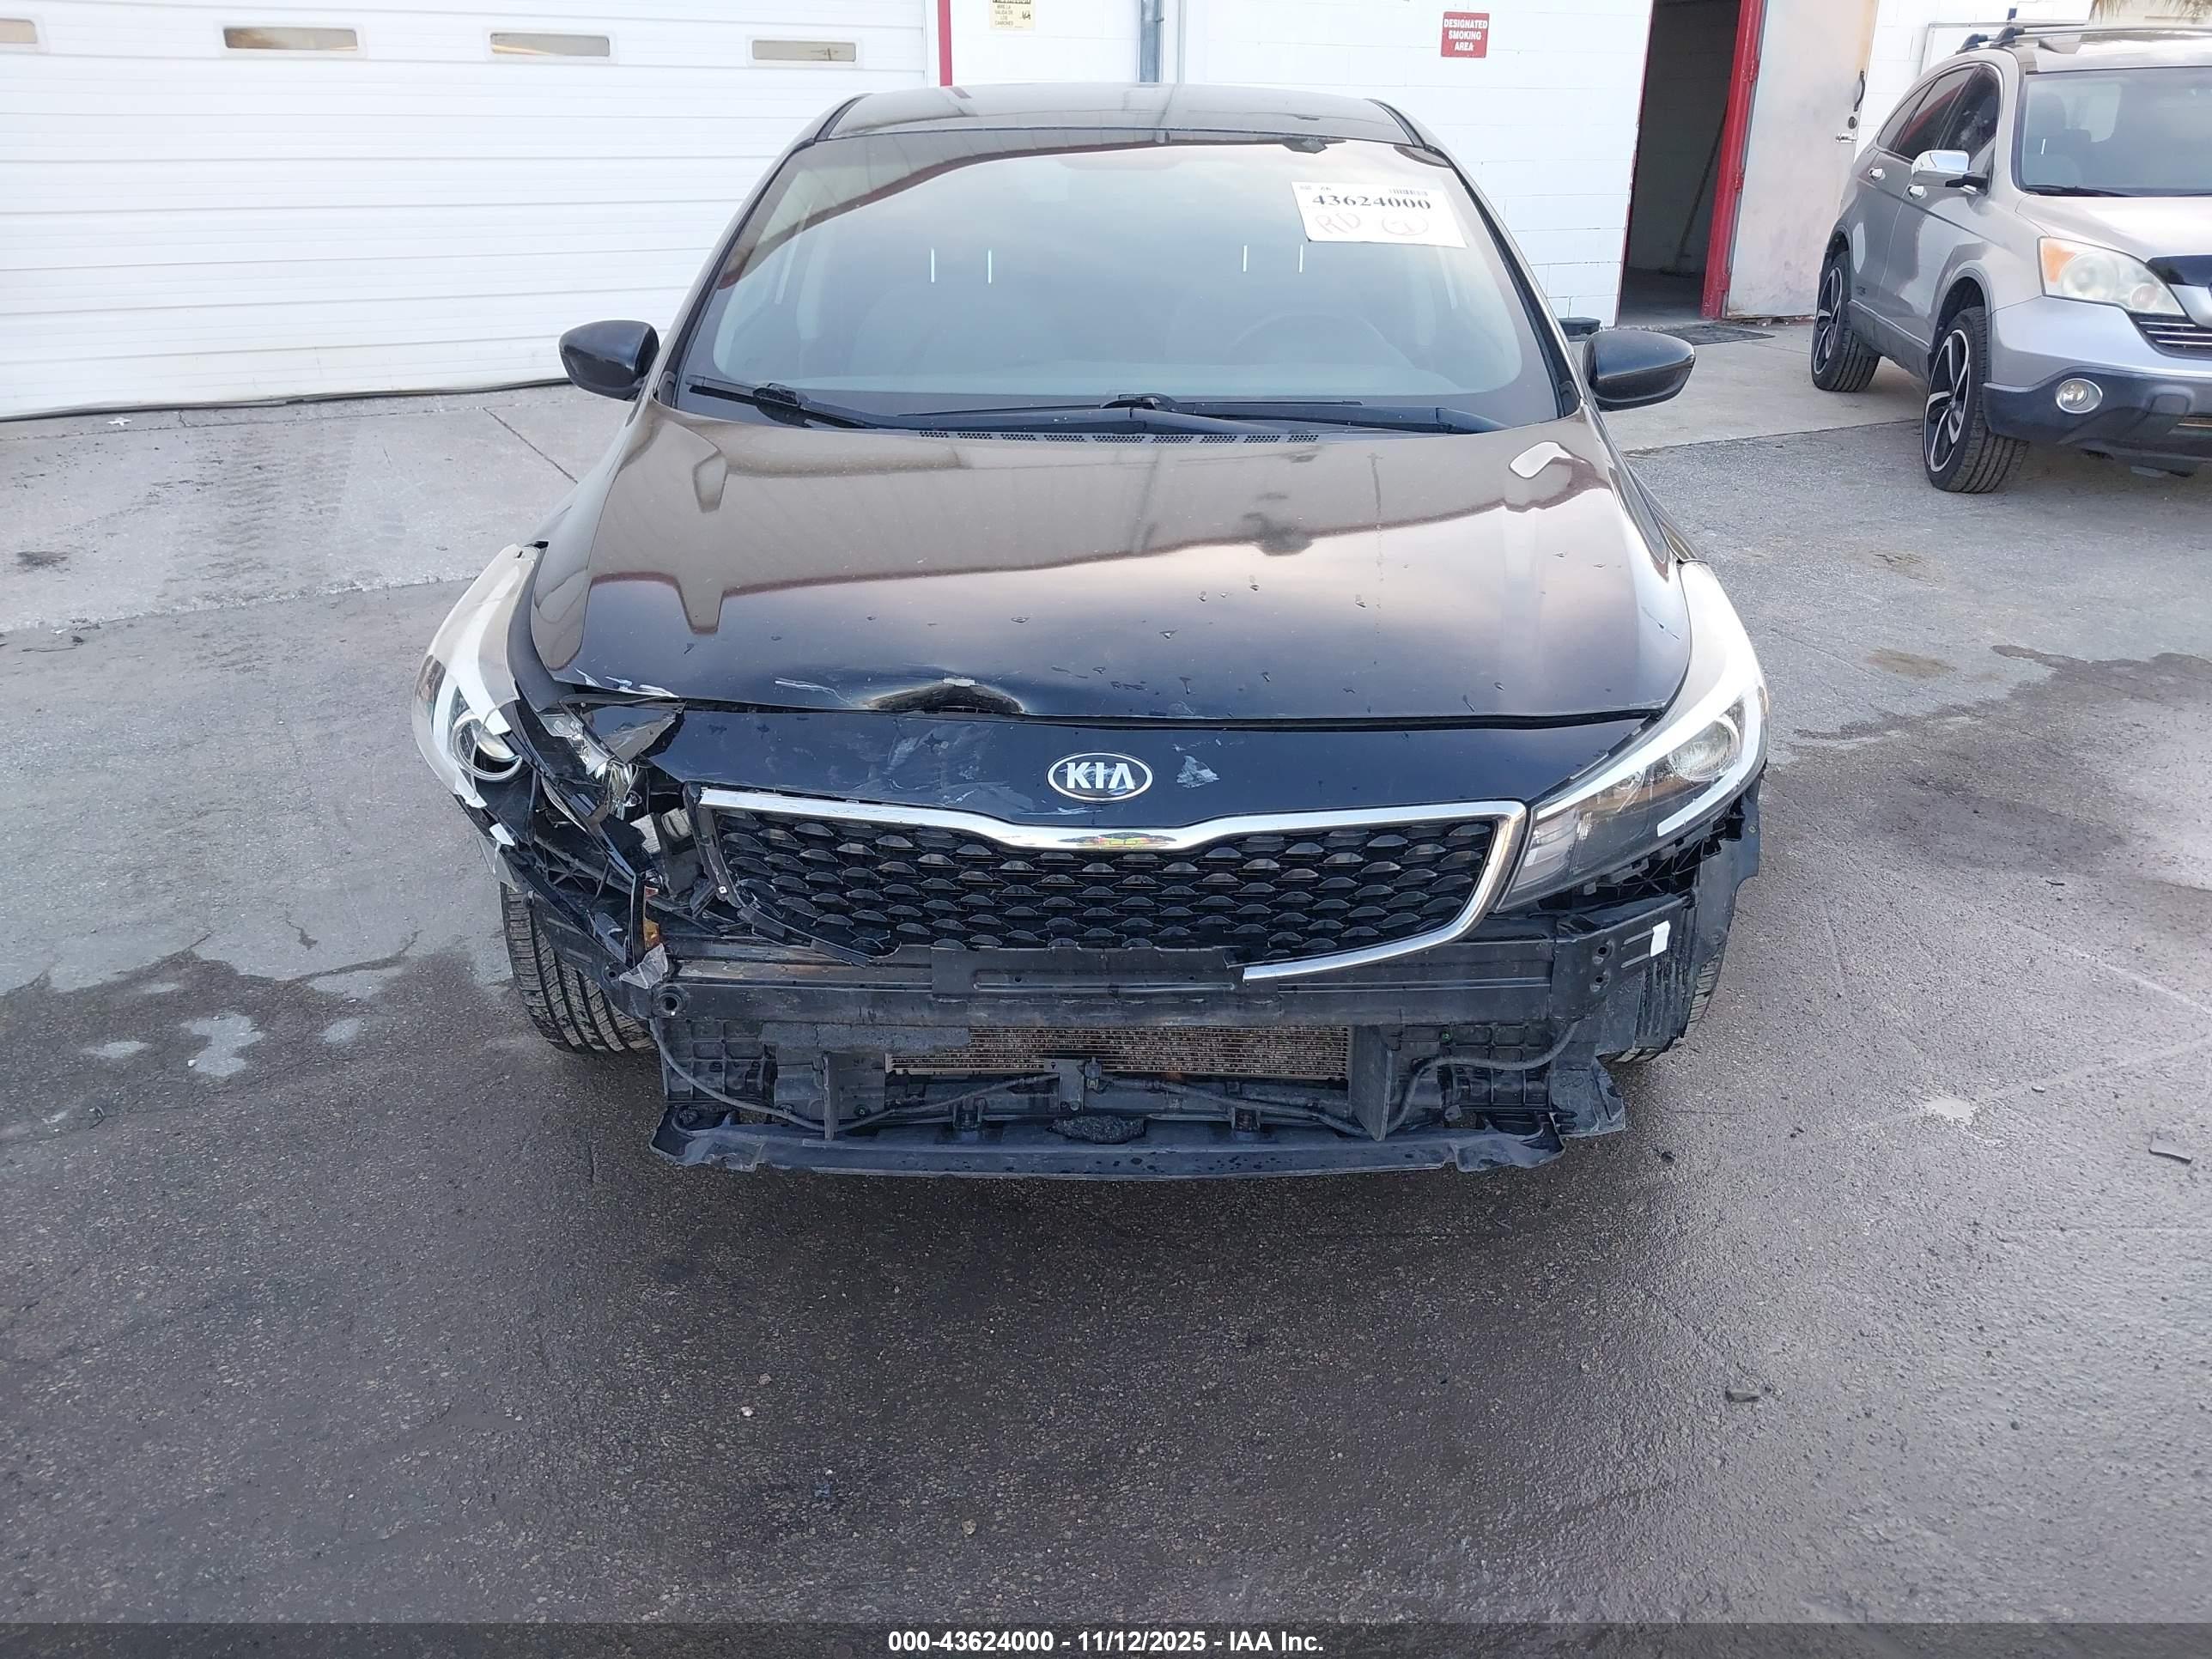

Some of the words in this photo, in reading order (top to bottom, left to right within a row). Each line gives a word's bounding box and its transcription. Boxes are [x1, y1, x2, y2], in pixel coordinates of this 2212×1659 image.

[1443, 18, 1488, 29] DESIGNATED
[1448, 30, 1482, 40] SMOKING
[1455, 41, 1474, 52] AREA
[1310, 194, 1432, 210] 43624000
[1066, 762, 1135, 790] KIA
